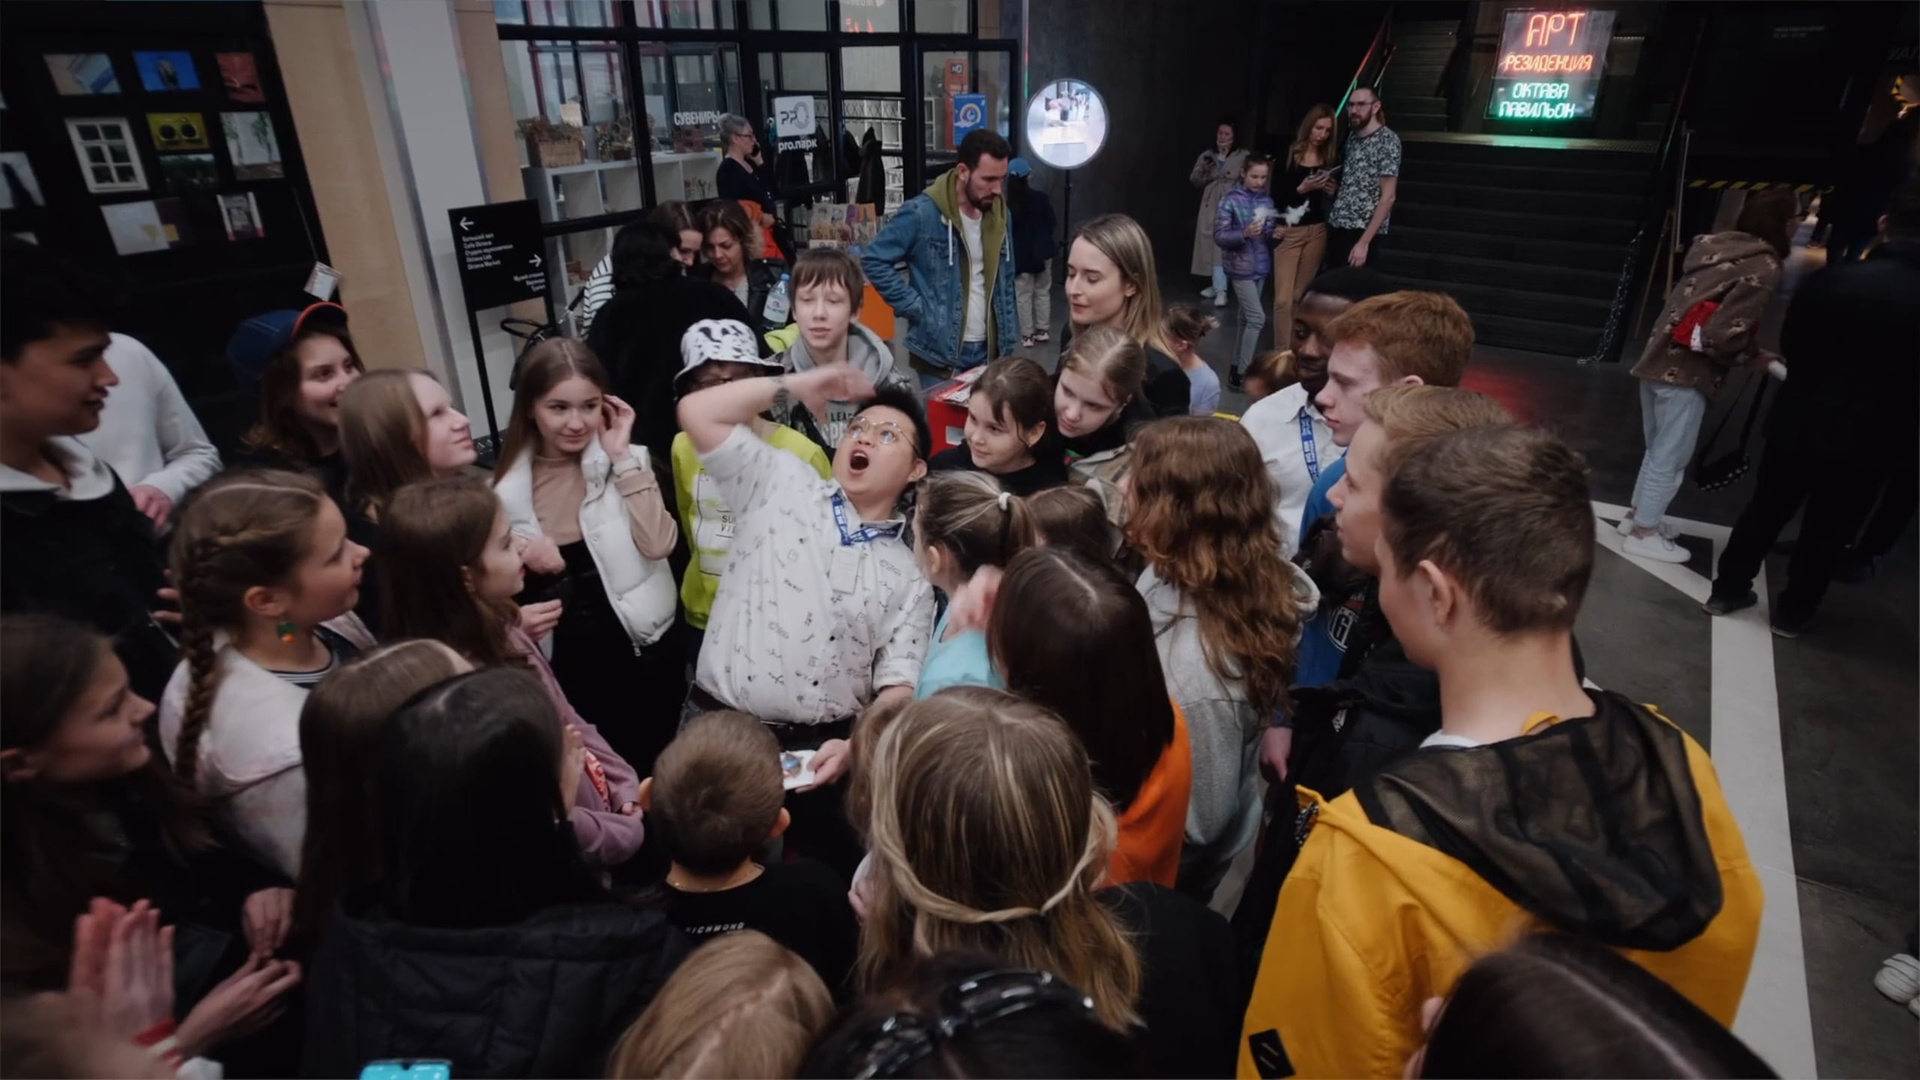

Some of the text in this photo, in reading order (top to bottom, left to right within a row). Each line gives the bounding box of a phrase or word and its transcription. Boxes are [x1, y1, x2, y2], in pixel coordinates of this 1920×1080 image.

[1525, 12, 1586, 47] АРТ
[1504, 54, 1593, 72] РЕЗИДЕНЦИЯ
[1512, 82, 1569, 99] ОКТАВА
[673, 110, 720, 126] СУВЕНИРЫ
[1498, 101, 1576, 119] ПАВИЛЬОН
[778, 139, 818, 154] pro.парк
